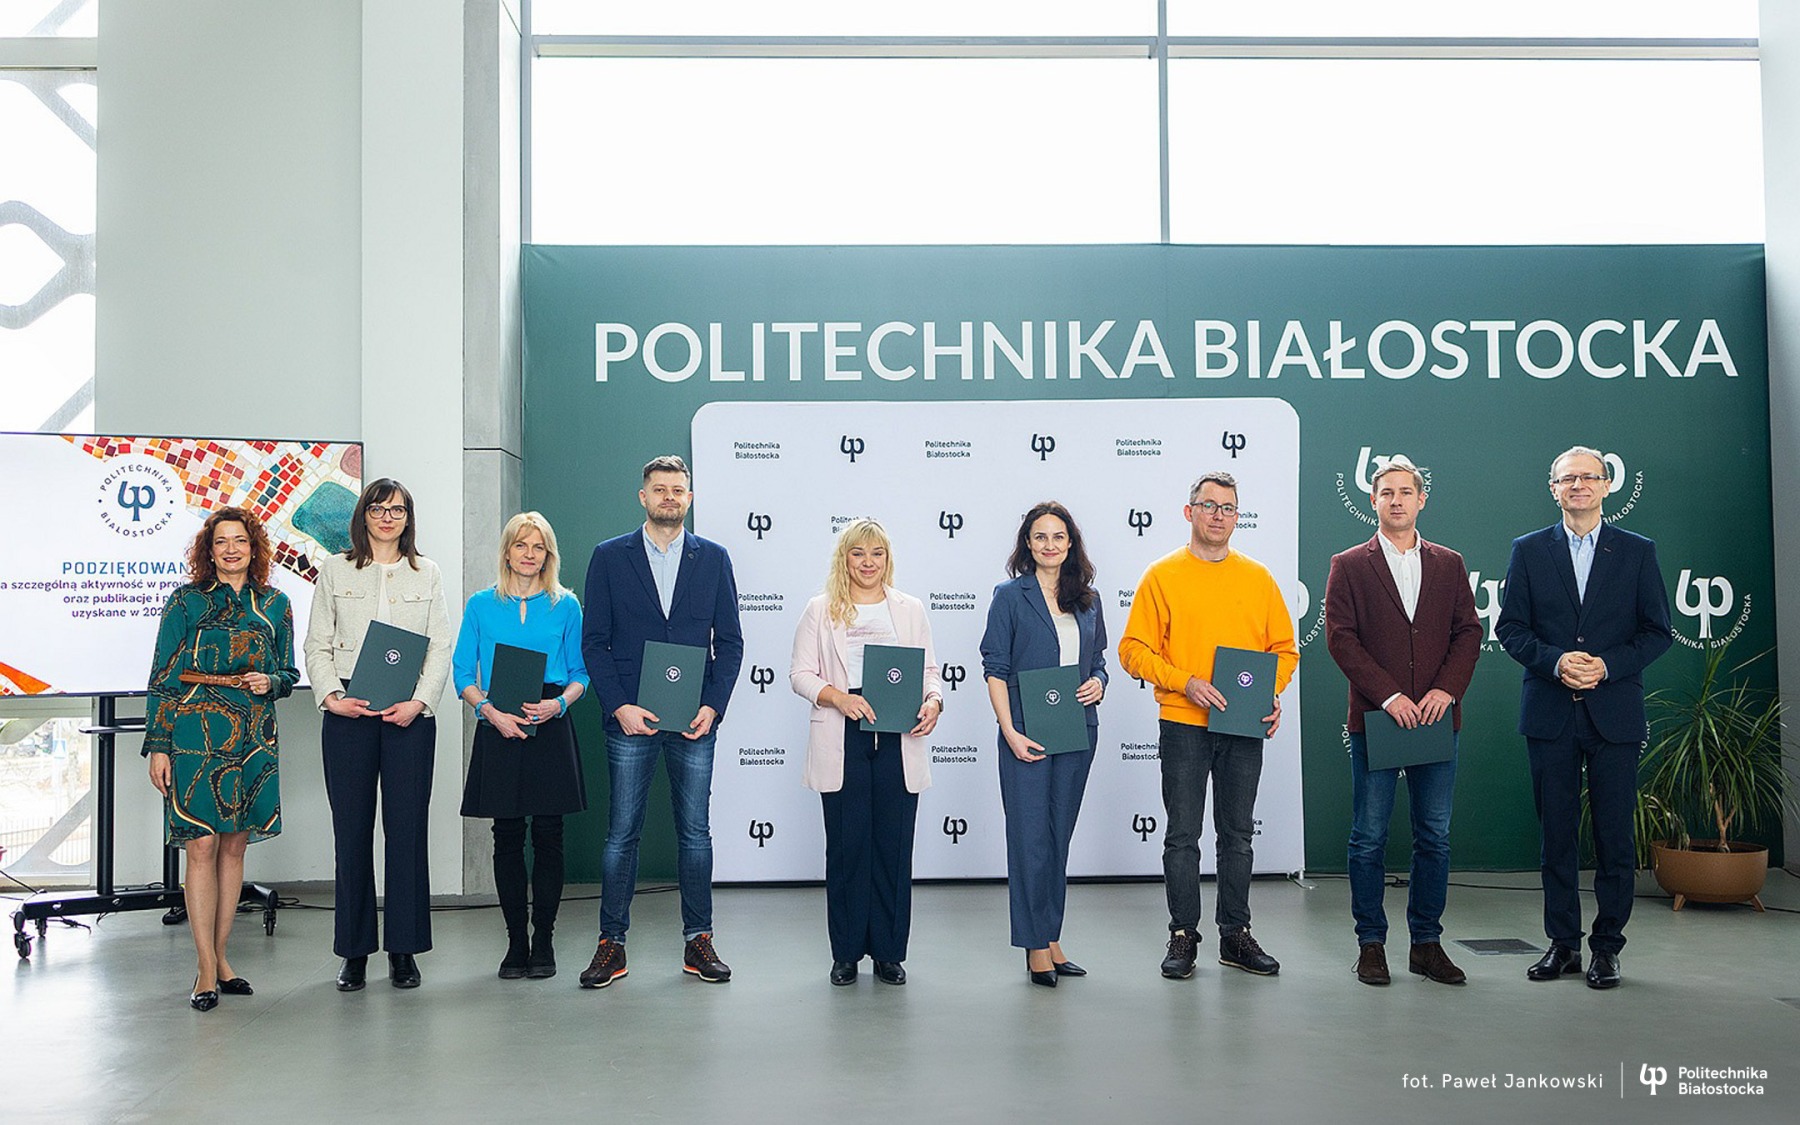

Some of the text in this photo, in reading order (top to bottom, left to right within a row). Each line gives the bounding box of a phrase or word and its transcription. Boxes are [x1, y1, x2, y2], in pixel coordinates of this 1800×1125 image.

[595, 319, 1738, 382] POLITECHNIKA BIAŁOSTOCKA
[733, 441, 780, 450] Politechnika
[925, 440, 971, 449] Politechnika
[1116, 438, 1162, 447] Politechnika
[735, 451, 780, 460] Białostocka
[926, 450, 970, 458] Białostocka
[1117, 448, 1161, 456] Białostocka
[100, 464, 172, 537] POLITECHNIKA BIAŁOSTOCKA
[11, 580, 77, 592] szczególną
[80, 579, 143, 591] aktywność
[146, 581, 156, 589] w
[63, 596, 90, 604] oraz
[92, 593, 152, 606] publikacje
[156, 593, 159, 603] i
[930, 592, 976, 601] Politechnika
[931, 602, 975, 611] Białostocka
[72, 608, 127, 620] uzyskane
[130, 609, 140, 617] w
[1299, 597, 1327, 648] ŁOSTOCKA
[1670, 625, 1705, 650] CHNIKA
[931, 745, 978, 754] Politechnika
[1120, 742, 1160, 751] Politechni
[739, 747, 786, 756] Politechnika
[932, 755, 977, 764] Białostocka
[1121, 752, 1161, 761] Białostock
[740, 757, 785, 766] Białostocka
